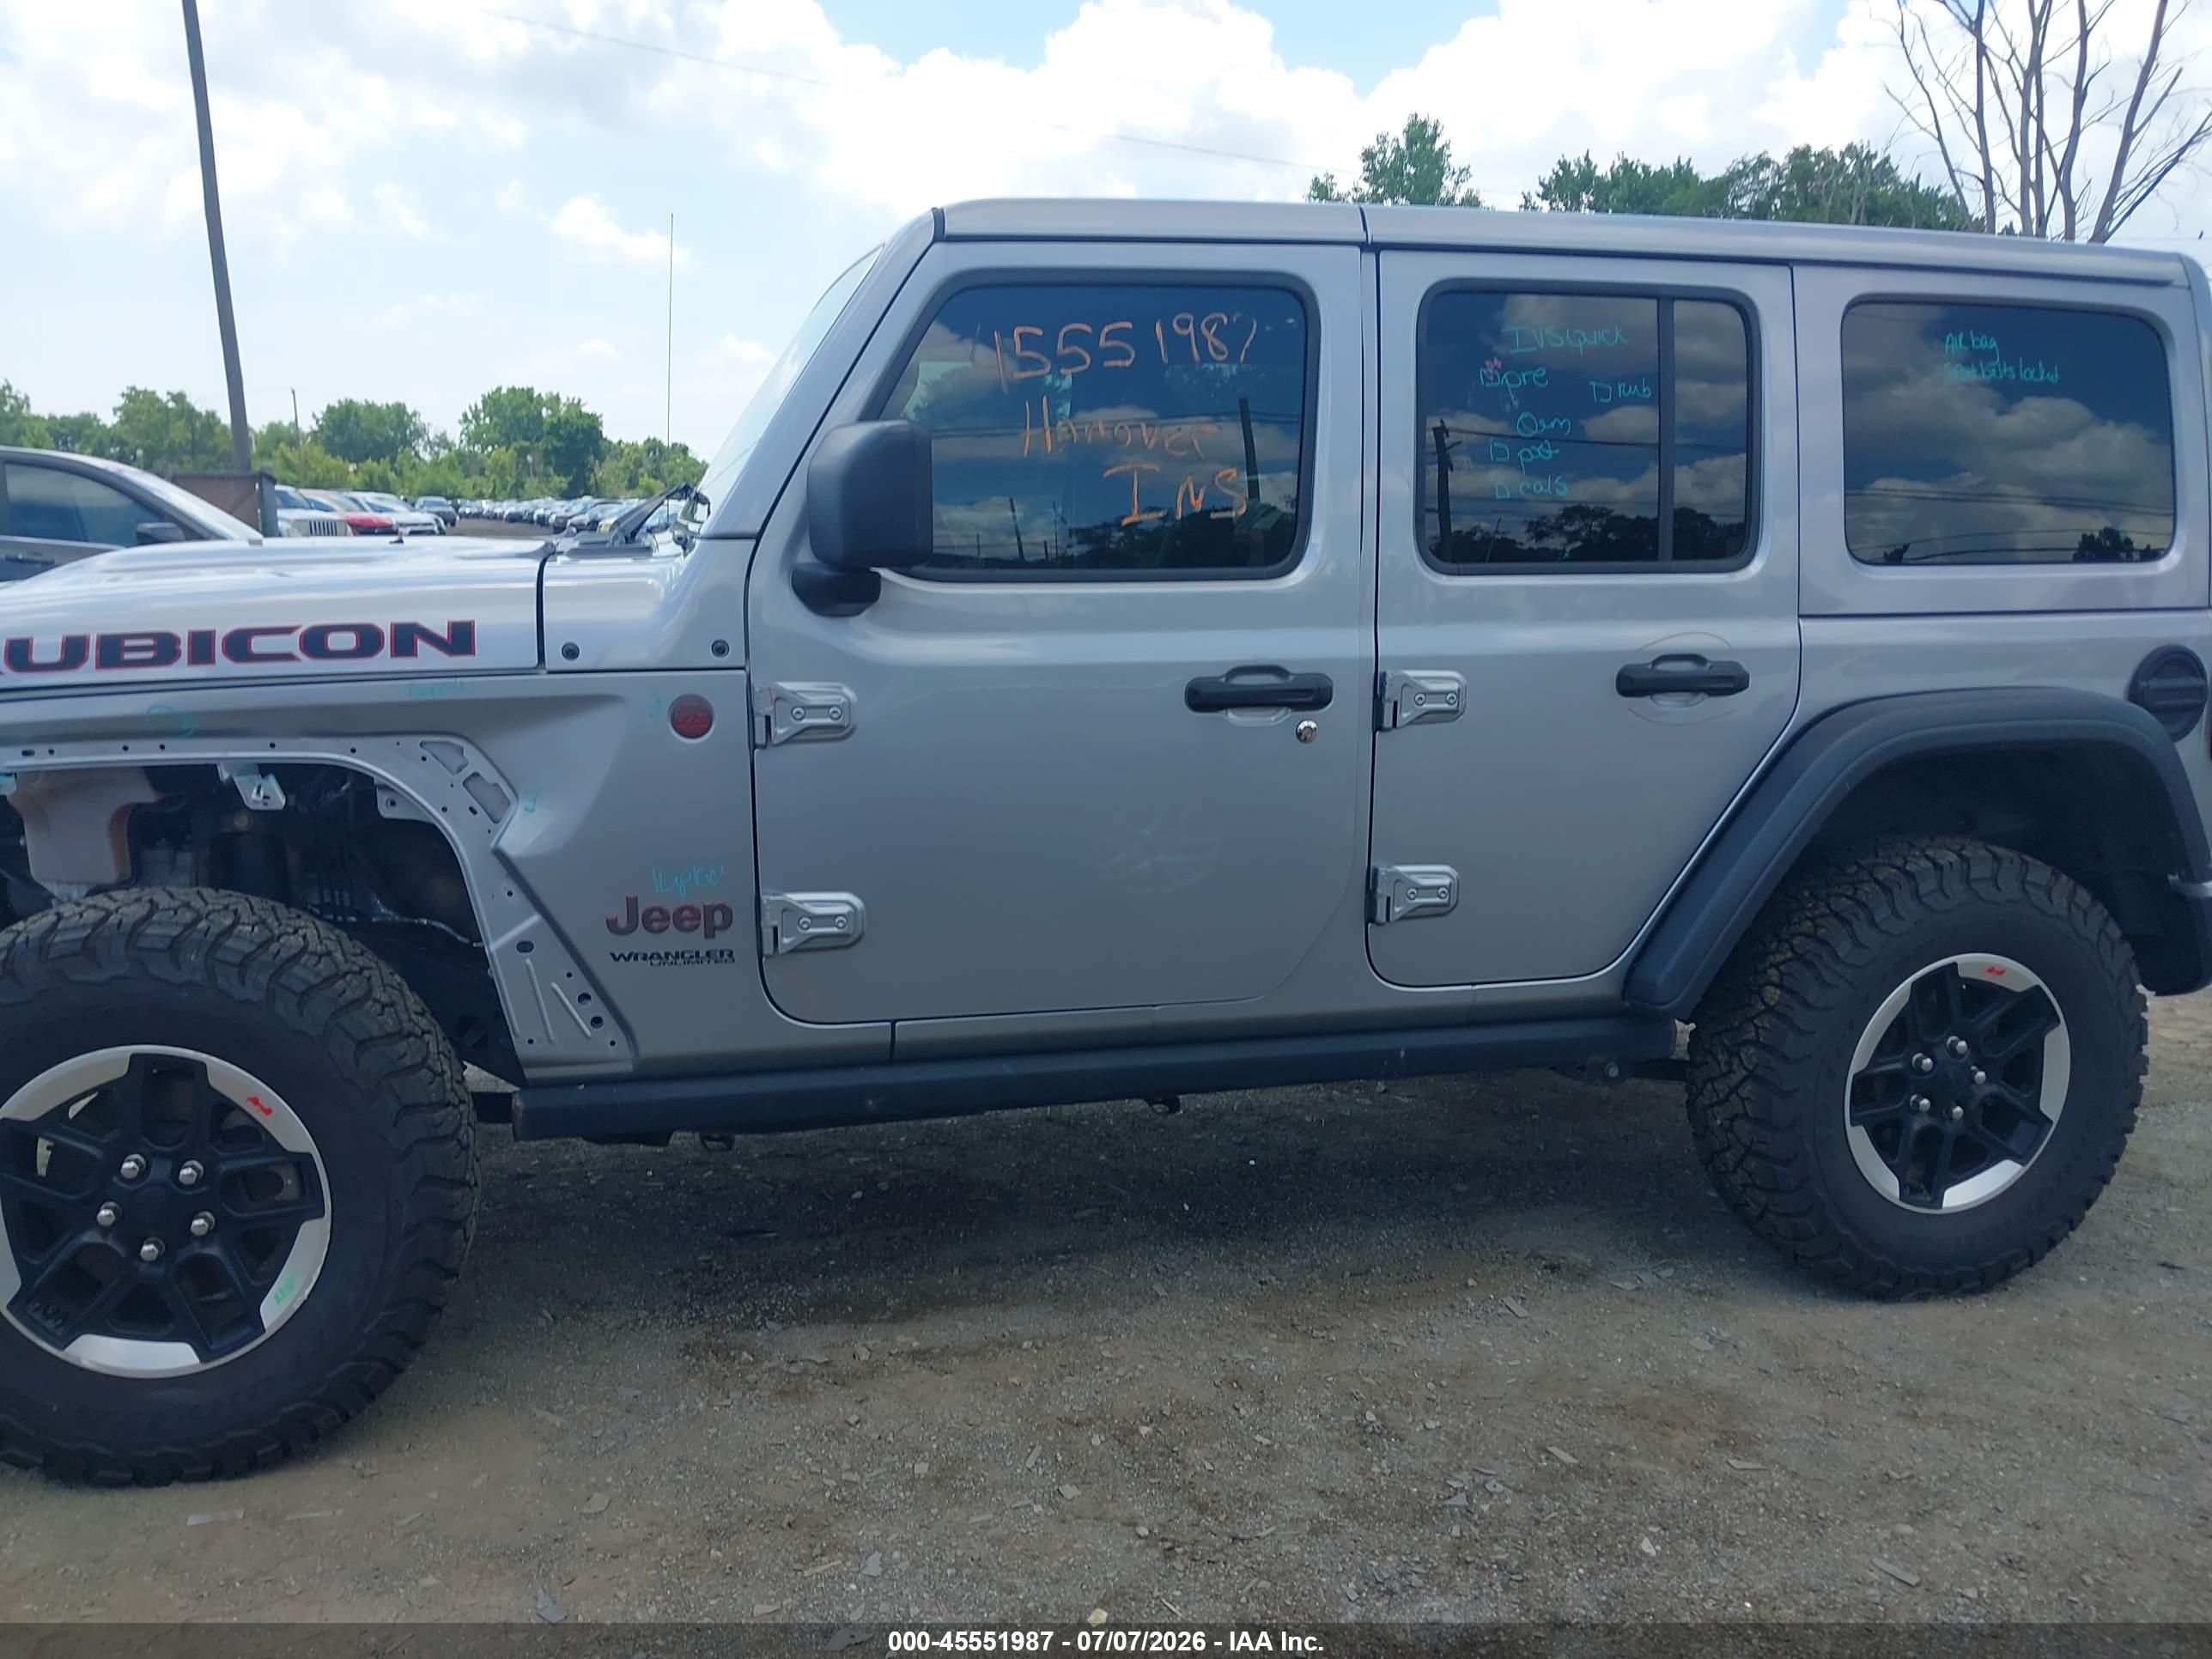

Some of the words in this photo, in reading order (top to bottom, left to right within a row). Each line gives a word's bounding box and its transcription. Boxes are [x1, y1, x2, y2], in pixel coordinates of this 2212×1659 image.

[0, 618, 477, 677] UBICON
[605, 894, 734, 940] Jeep
[609, 948, 735, 963] WRANGLER
